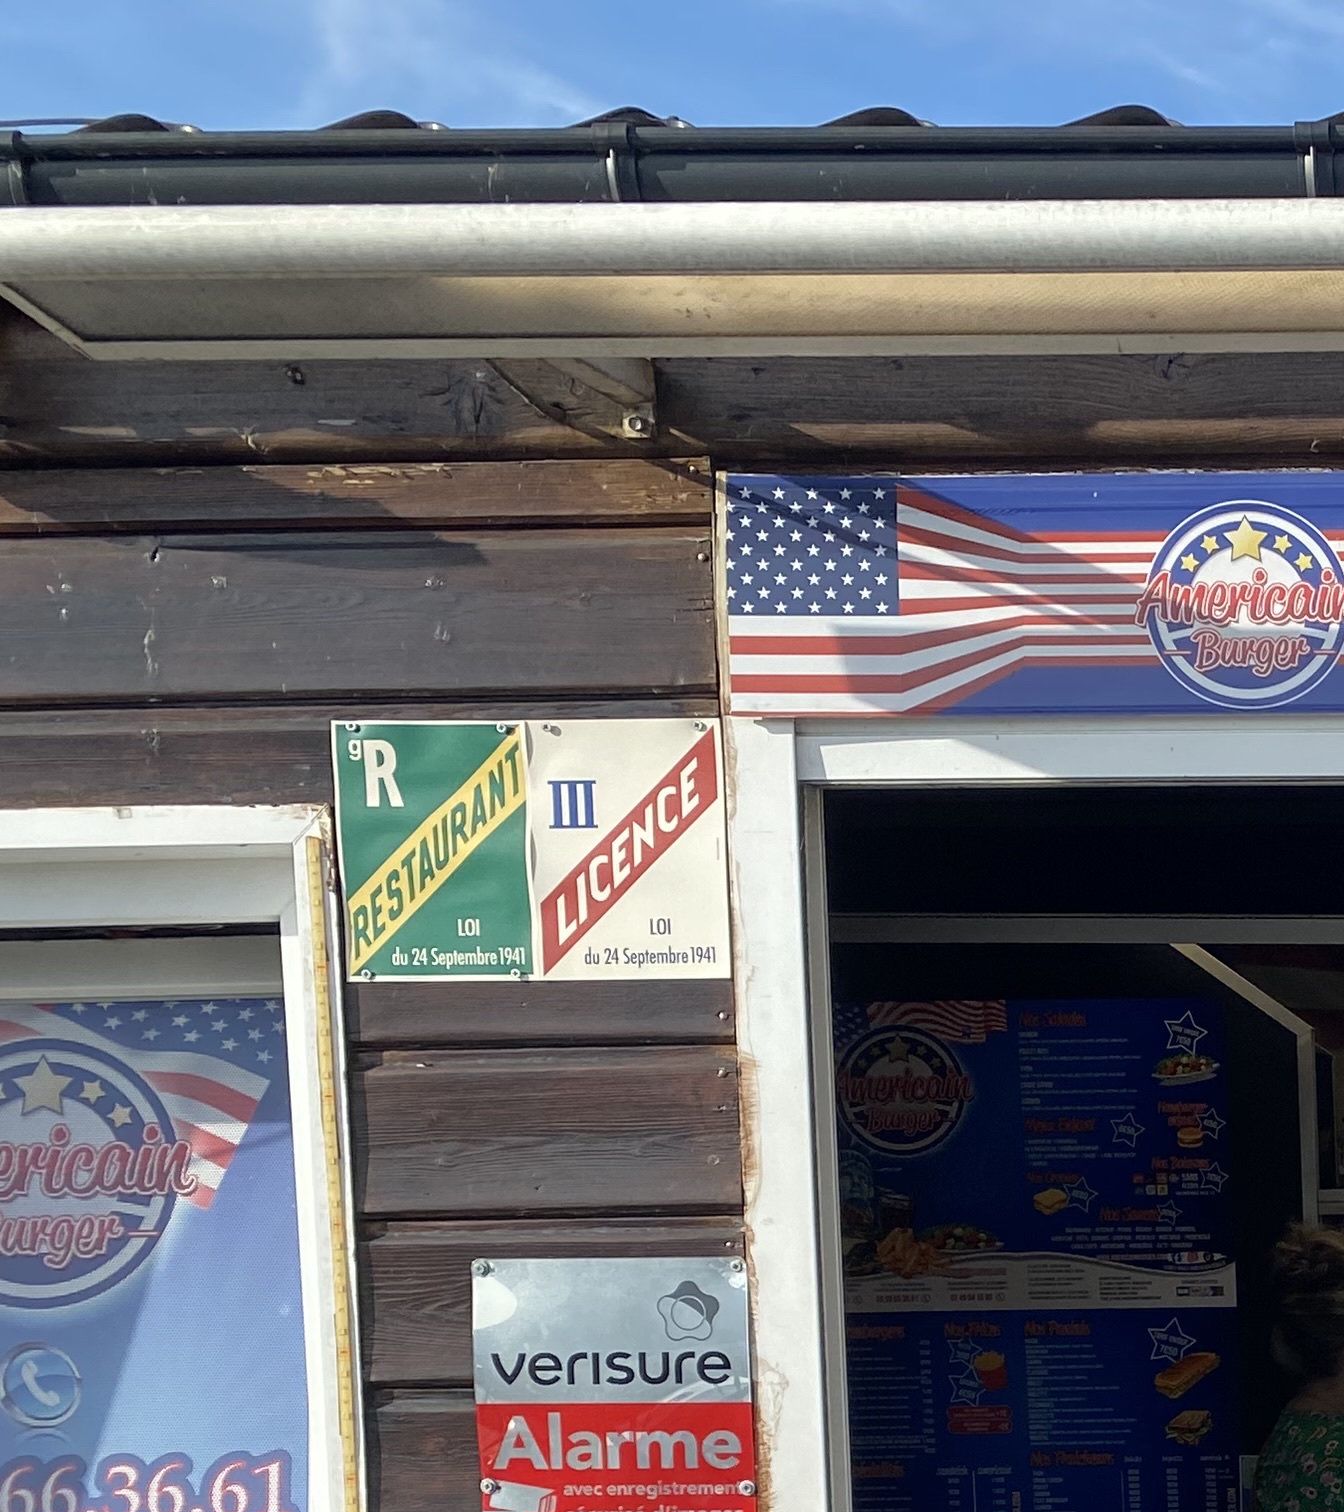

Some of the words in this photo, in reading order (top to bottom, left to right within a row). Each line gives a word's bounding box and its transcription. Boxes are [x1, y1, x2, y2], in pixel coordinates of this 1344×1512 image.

[1190, 628, 1311, 678] Burger
[351, 741, 521, 961] RESTAURANT
[556, 756, 698, 946] LICENCE
[457, 918, 480, 937] LOI
[649, 917, 672, 936] LOI
[392, 946, 409, 966] du
[411, 946, 428, 966] 24
[431, 946, 498, 969] Septembre
[498, 946, 526, 965] 1941
[584, 946, 601, 965] du
[603, 946, 620, 965] 24
[622, 946, 689, 969] Septembre
[690, 946, 717, 964] 1941
[0, 1213, 124, 1269] urger
[490, 1350, 732, 1387] verisure
[492, 1411, 743, 1472] Alarme
[563, 1484, 603, 1497] avec
